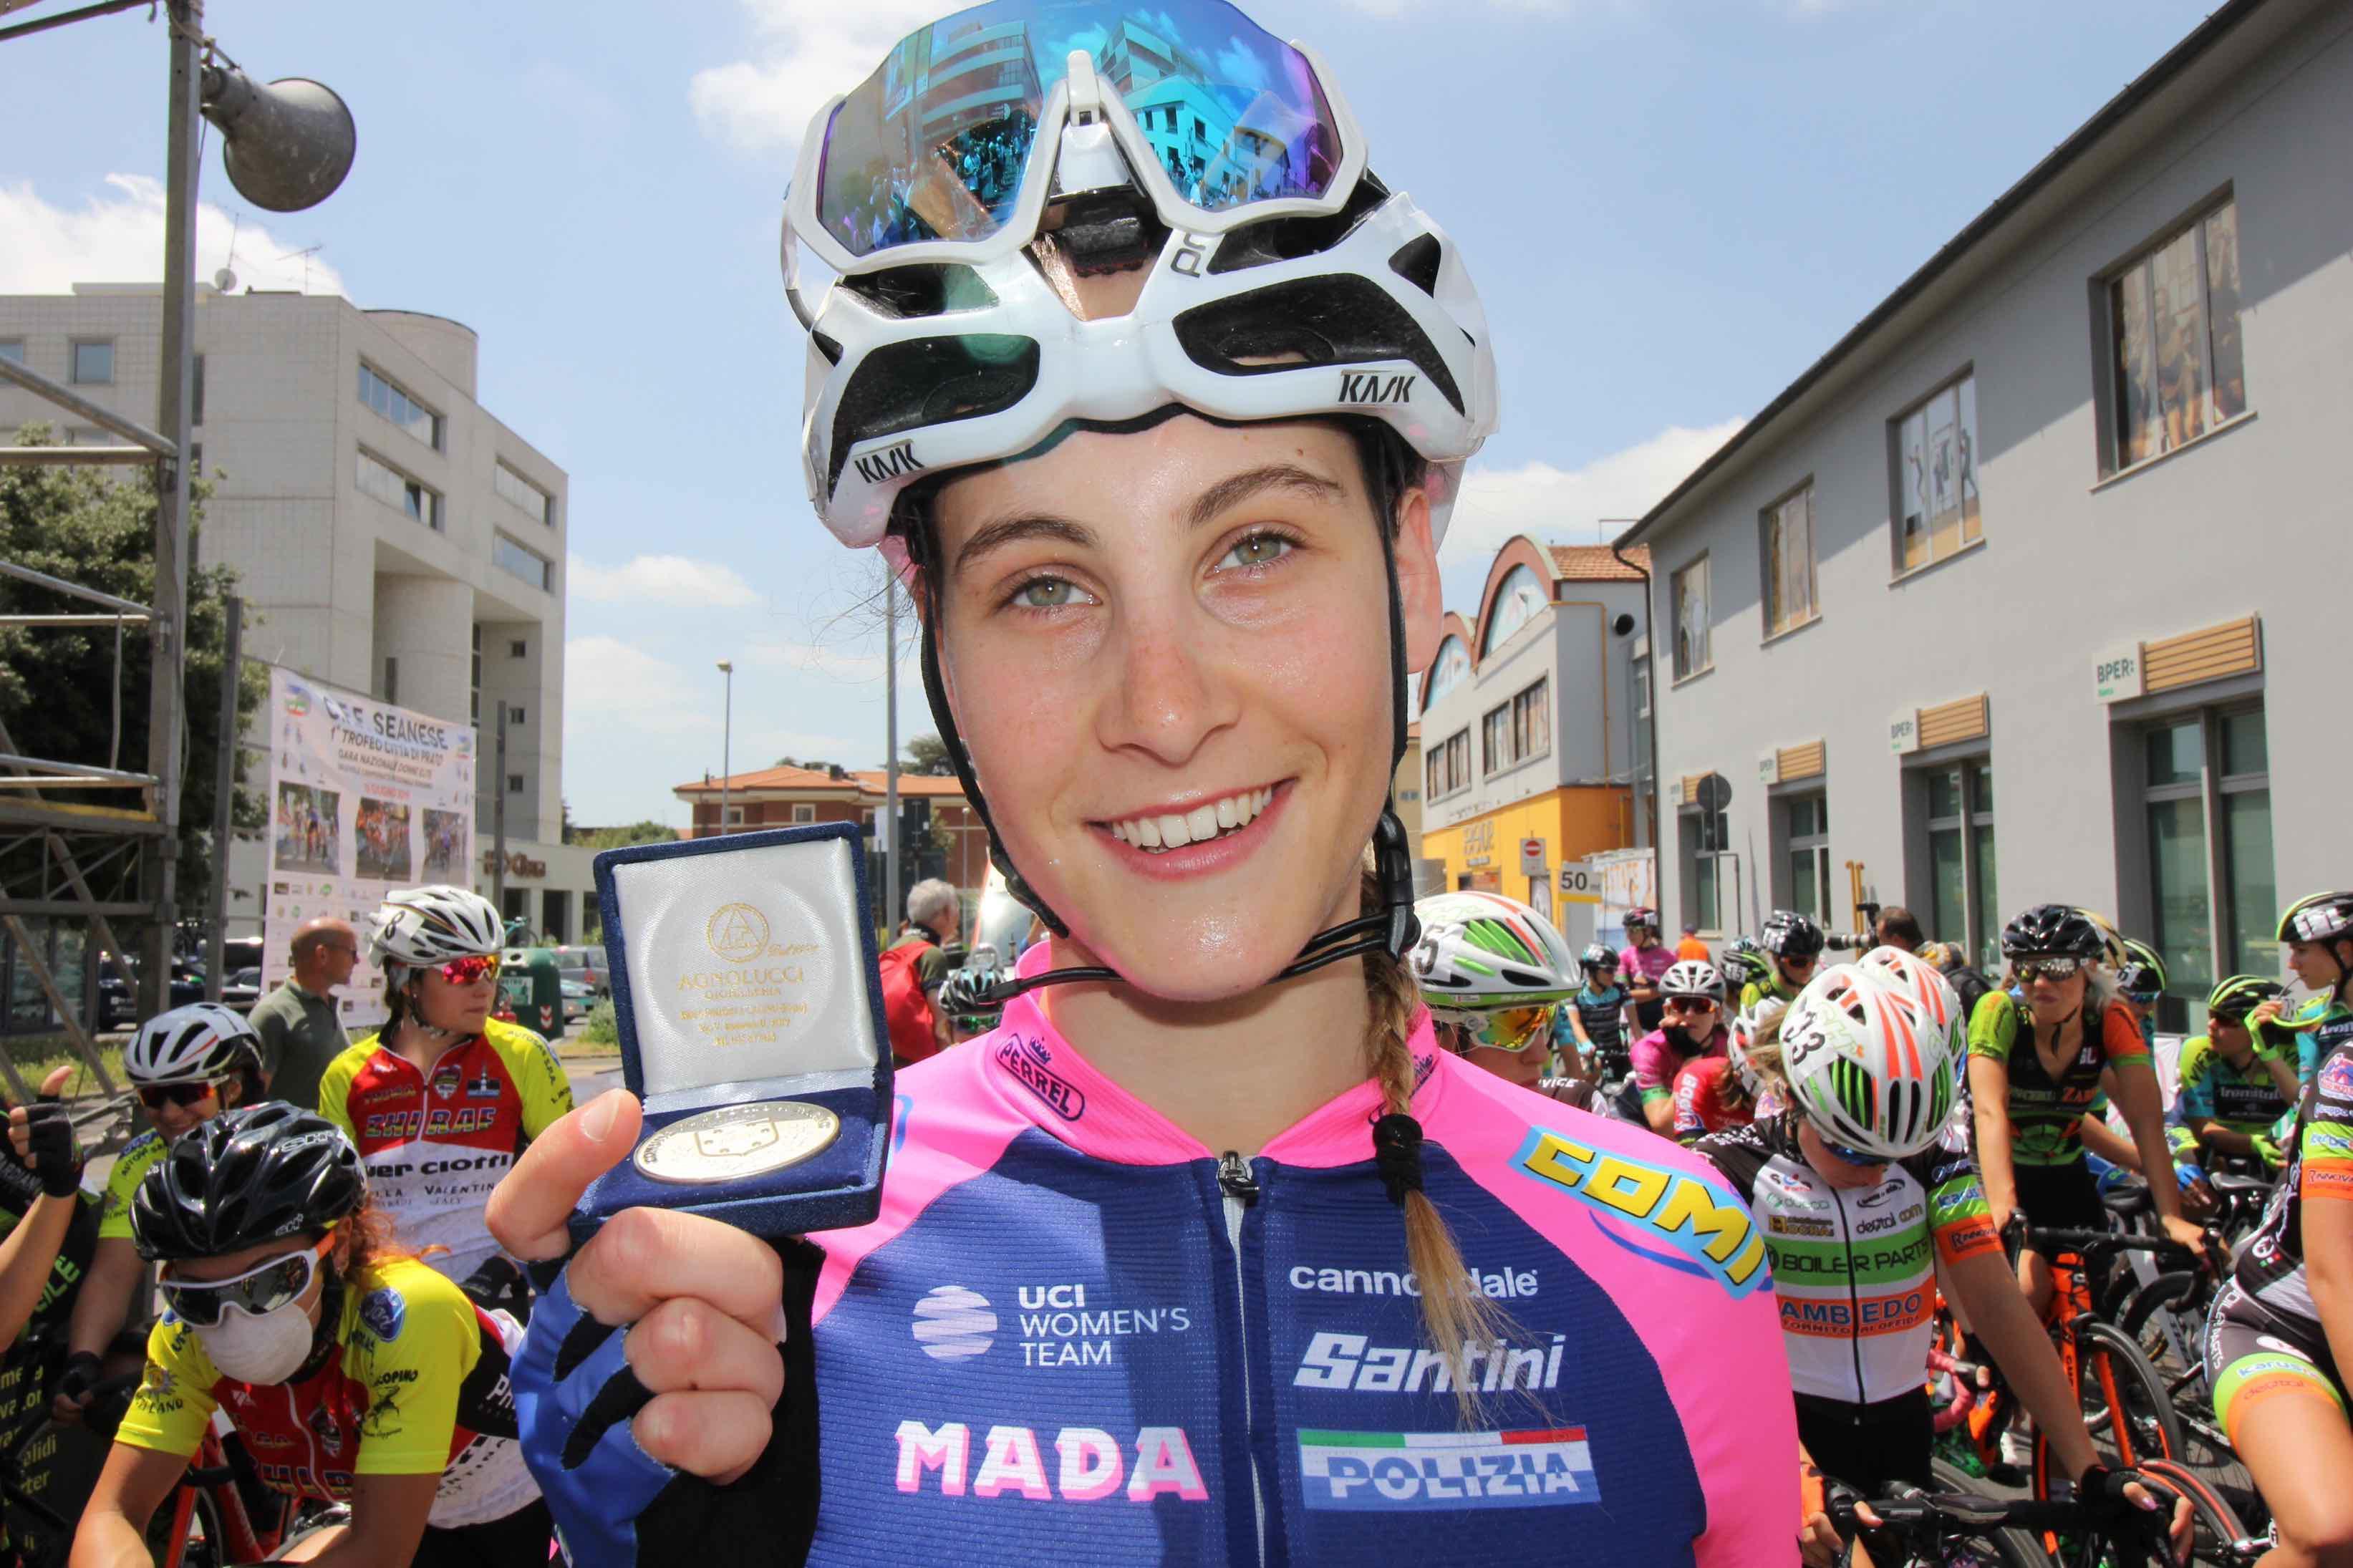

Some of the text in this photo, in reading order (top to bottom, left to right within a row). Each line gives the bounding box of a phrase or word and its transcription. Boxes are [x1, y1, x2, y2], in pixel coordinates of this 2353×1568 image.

[1338, 374, 1416, 402] KASK
[854, 442, 925, 483] KASK
[342, 729, 383, 752] TROFEO
[373, 711, 449, 751] SEANESE
[1561, 871, 1588, 891] 50
[1000, 1040, 1073, 1115] PERREL
[1538, 1078, 1579, 1088] VICE
[424, 1182, 496, 1196] VALENTIN
[1782, 1253, 1870, 1274] BOILER
[1018, 1283, 1086, 1310] UCI
[1019, 1307, 1191, 1338] WOMEN'S
[1019, 1340, 1112, 1367] TEAM
[1293, 1331, 1567, 1393] Santini
[894, 1418, 1210, 1502] MADA
[1327, 1452, 1580, 1501] POLIZIA
